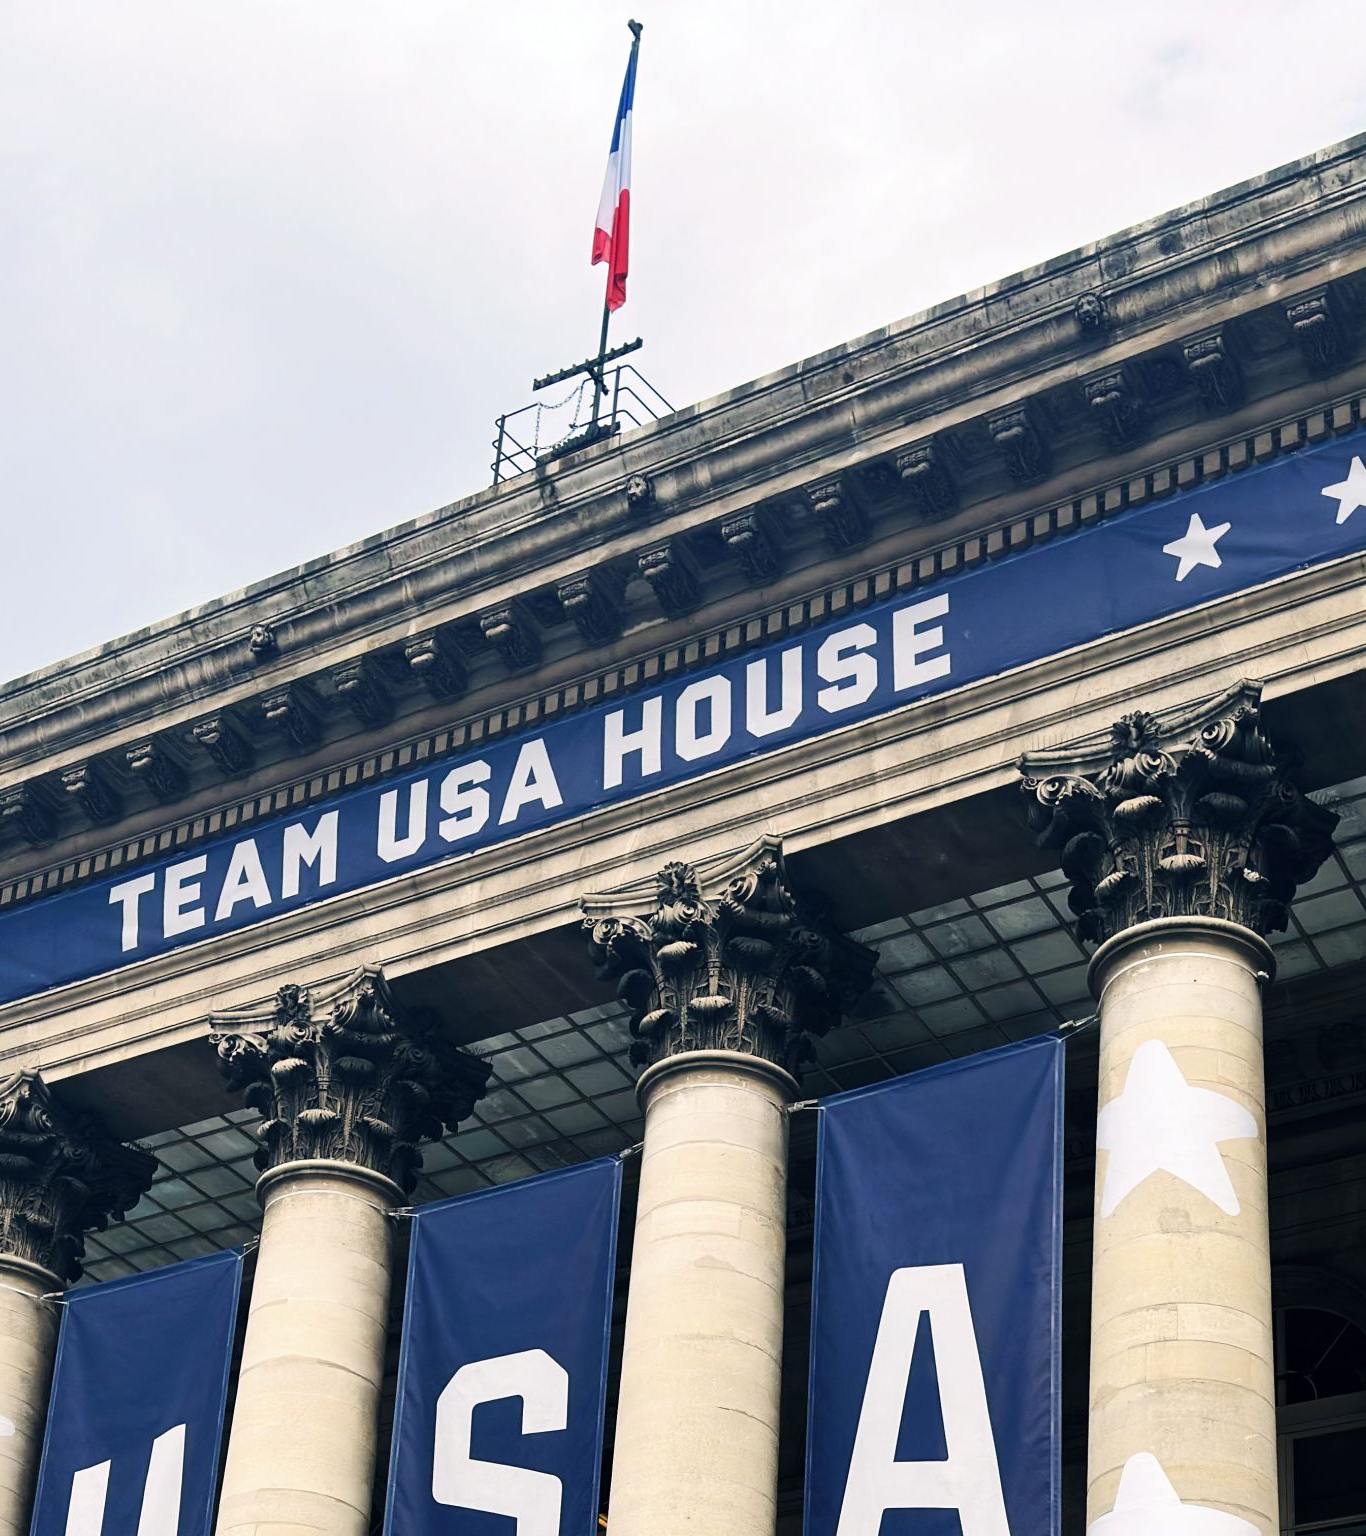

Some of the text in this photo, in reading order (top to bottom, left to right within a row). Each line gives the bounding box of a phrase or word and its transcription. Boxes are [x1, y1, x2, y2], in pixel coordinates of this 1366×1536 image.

[107, 593, 952, 953] TEAM USA HOUSE
